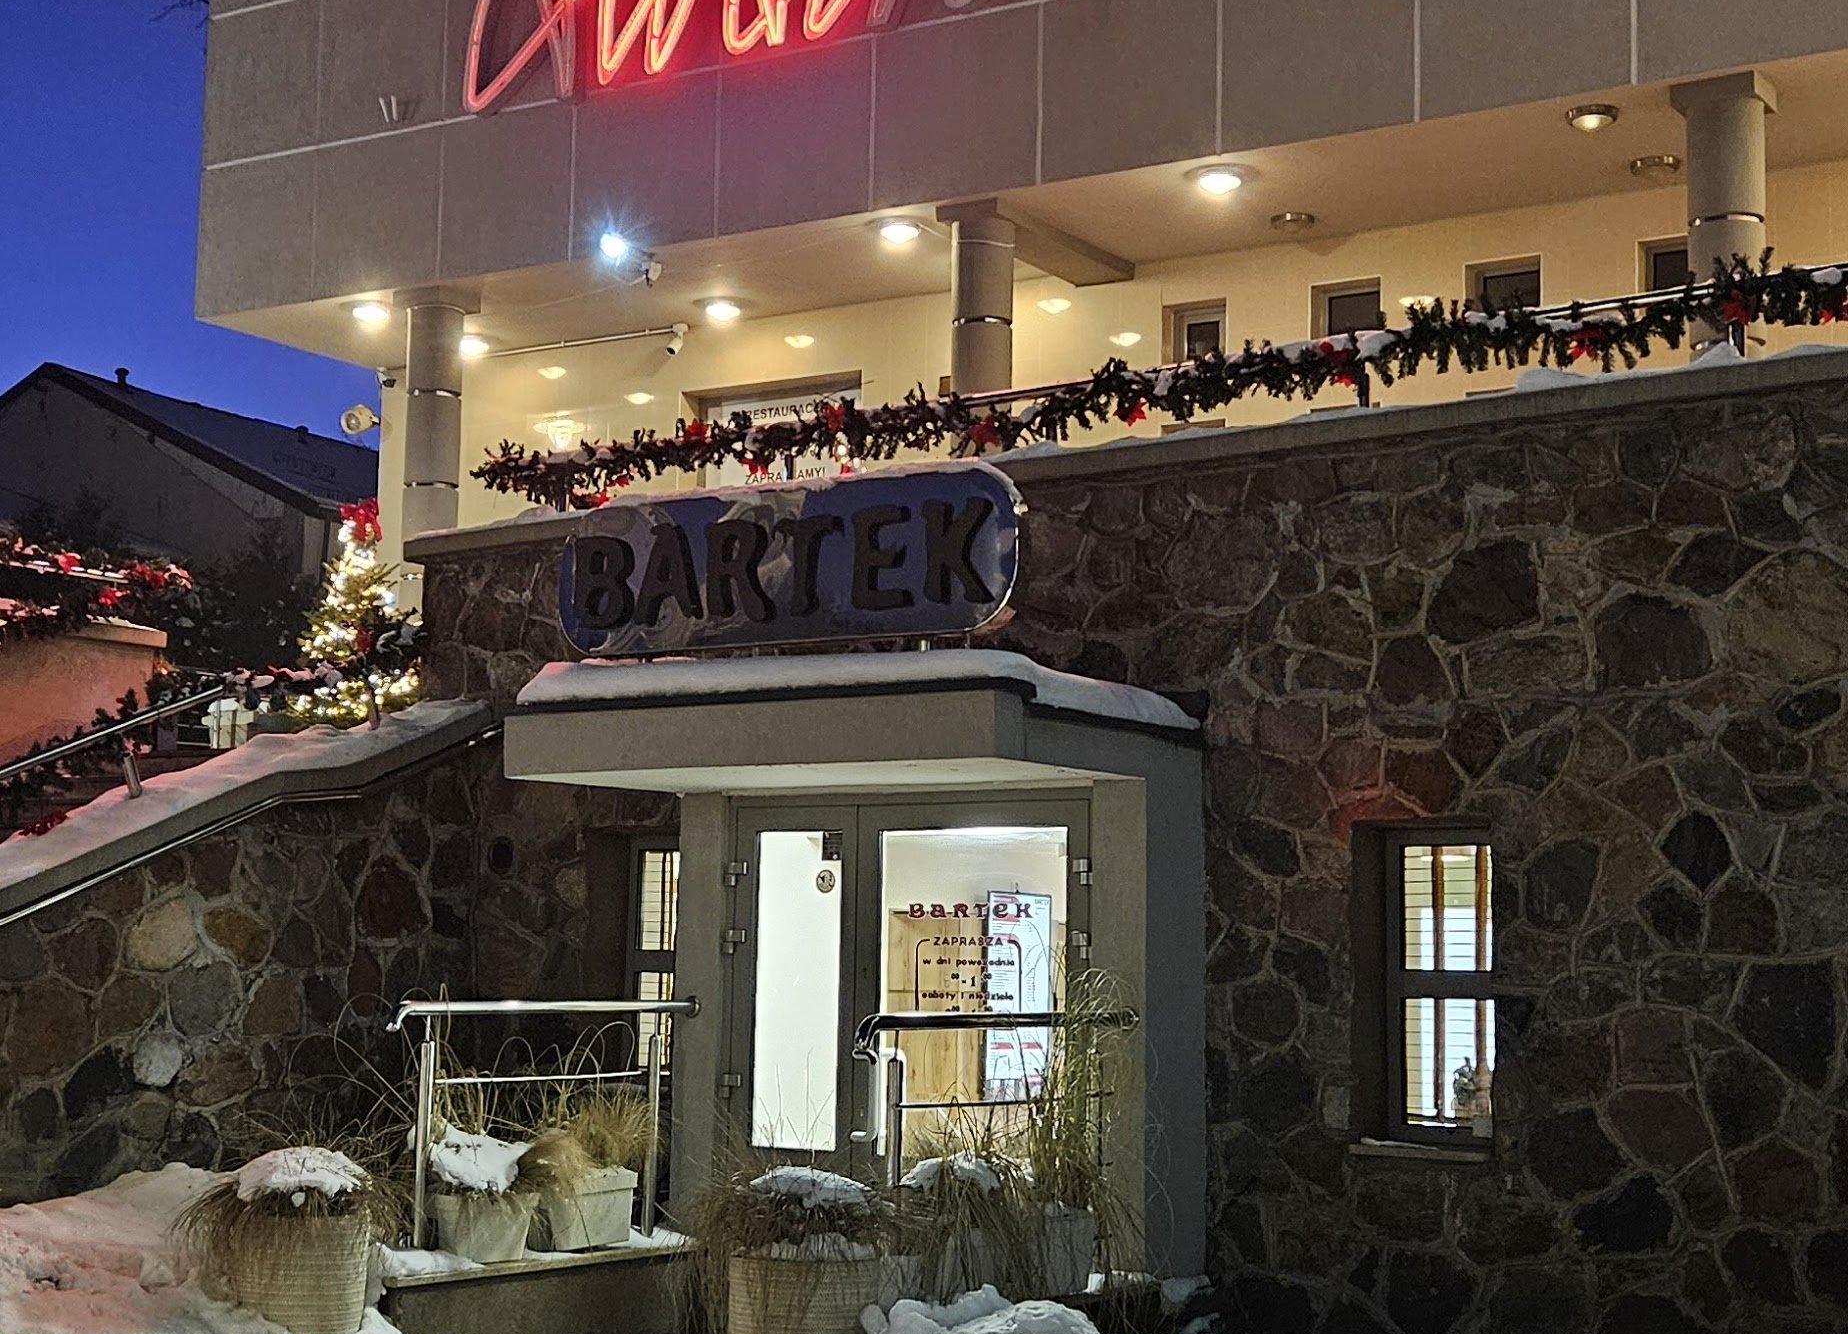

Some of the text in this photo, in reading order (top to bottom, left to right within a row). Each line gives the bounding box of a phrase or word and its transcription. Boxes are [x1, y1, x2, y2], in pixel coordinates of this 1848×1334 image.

[746, 402, 826, 421] RESTAURAC
[745, 466, 826, 485] ZAPRAAMY!
[573, 497, 996, 631] BARTEK
[933, 936, 1003, 946] ZAPRASZA
[936, 956, 951, 965] dni
